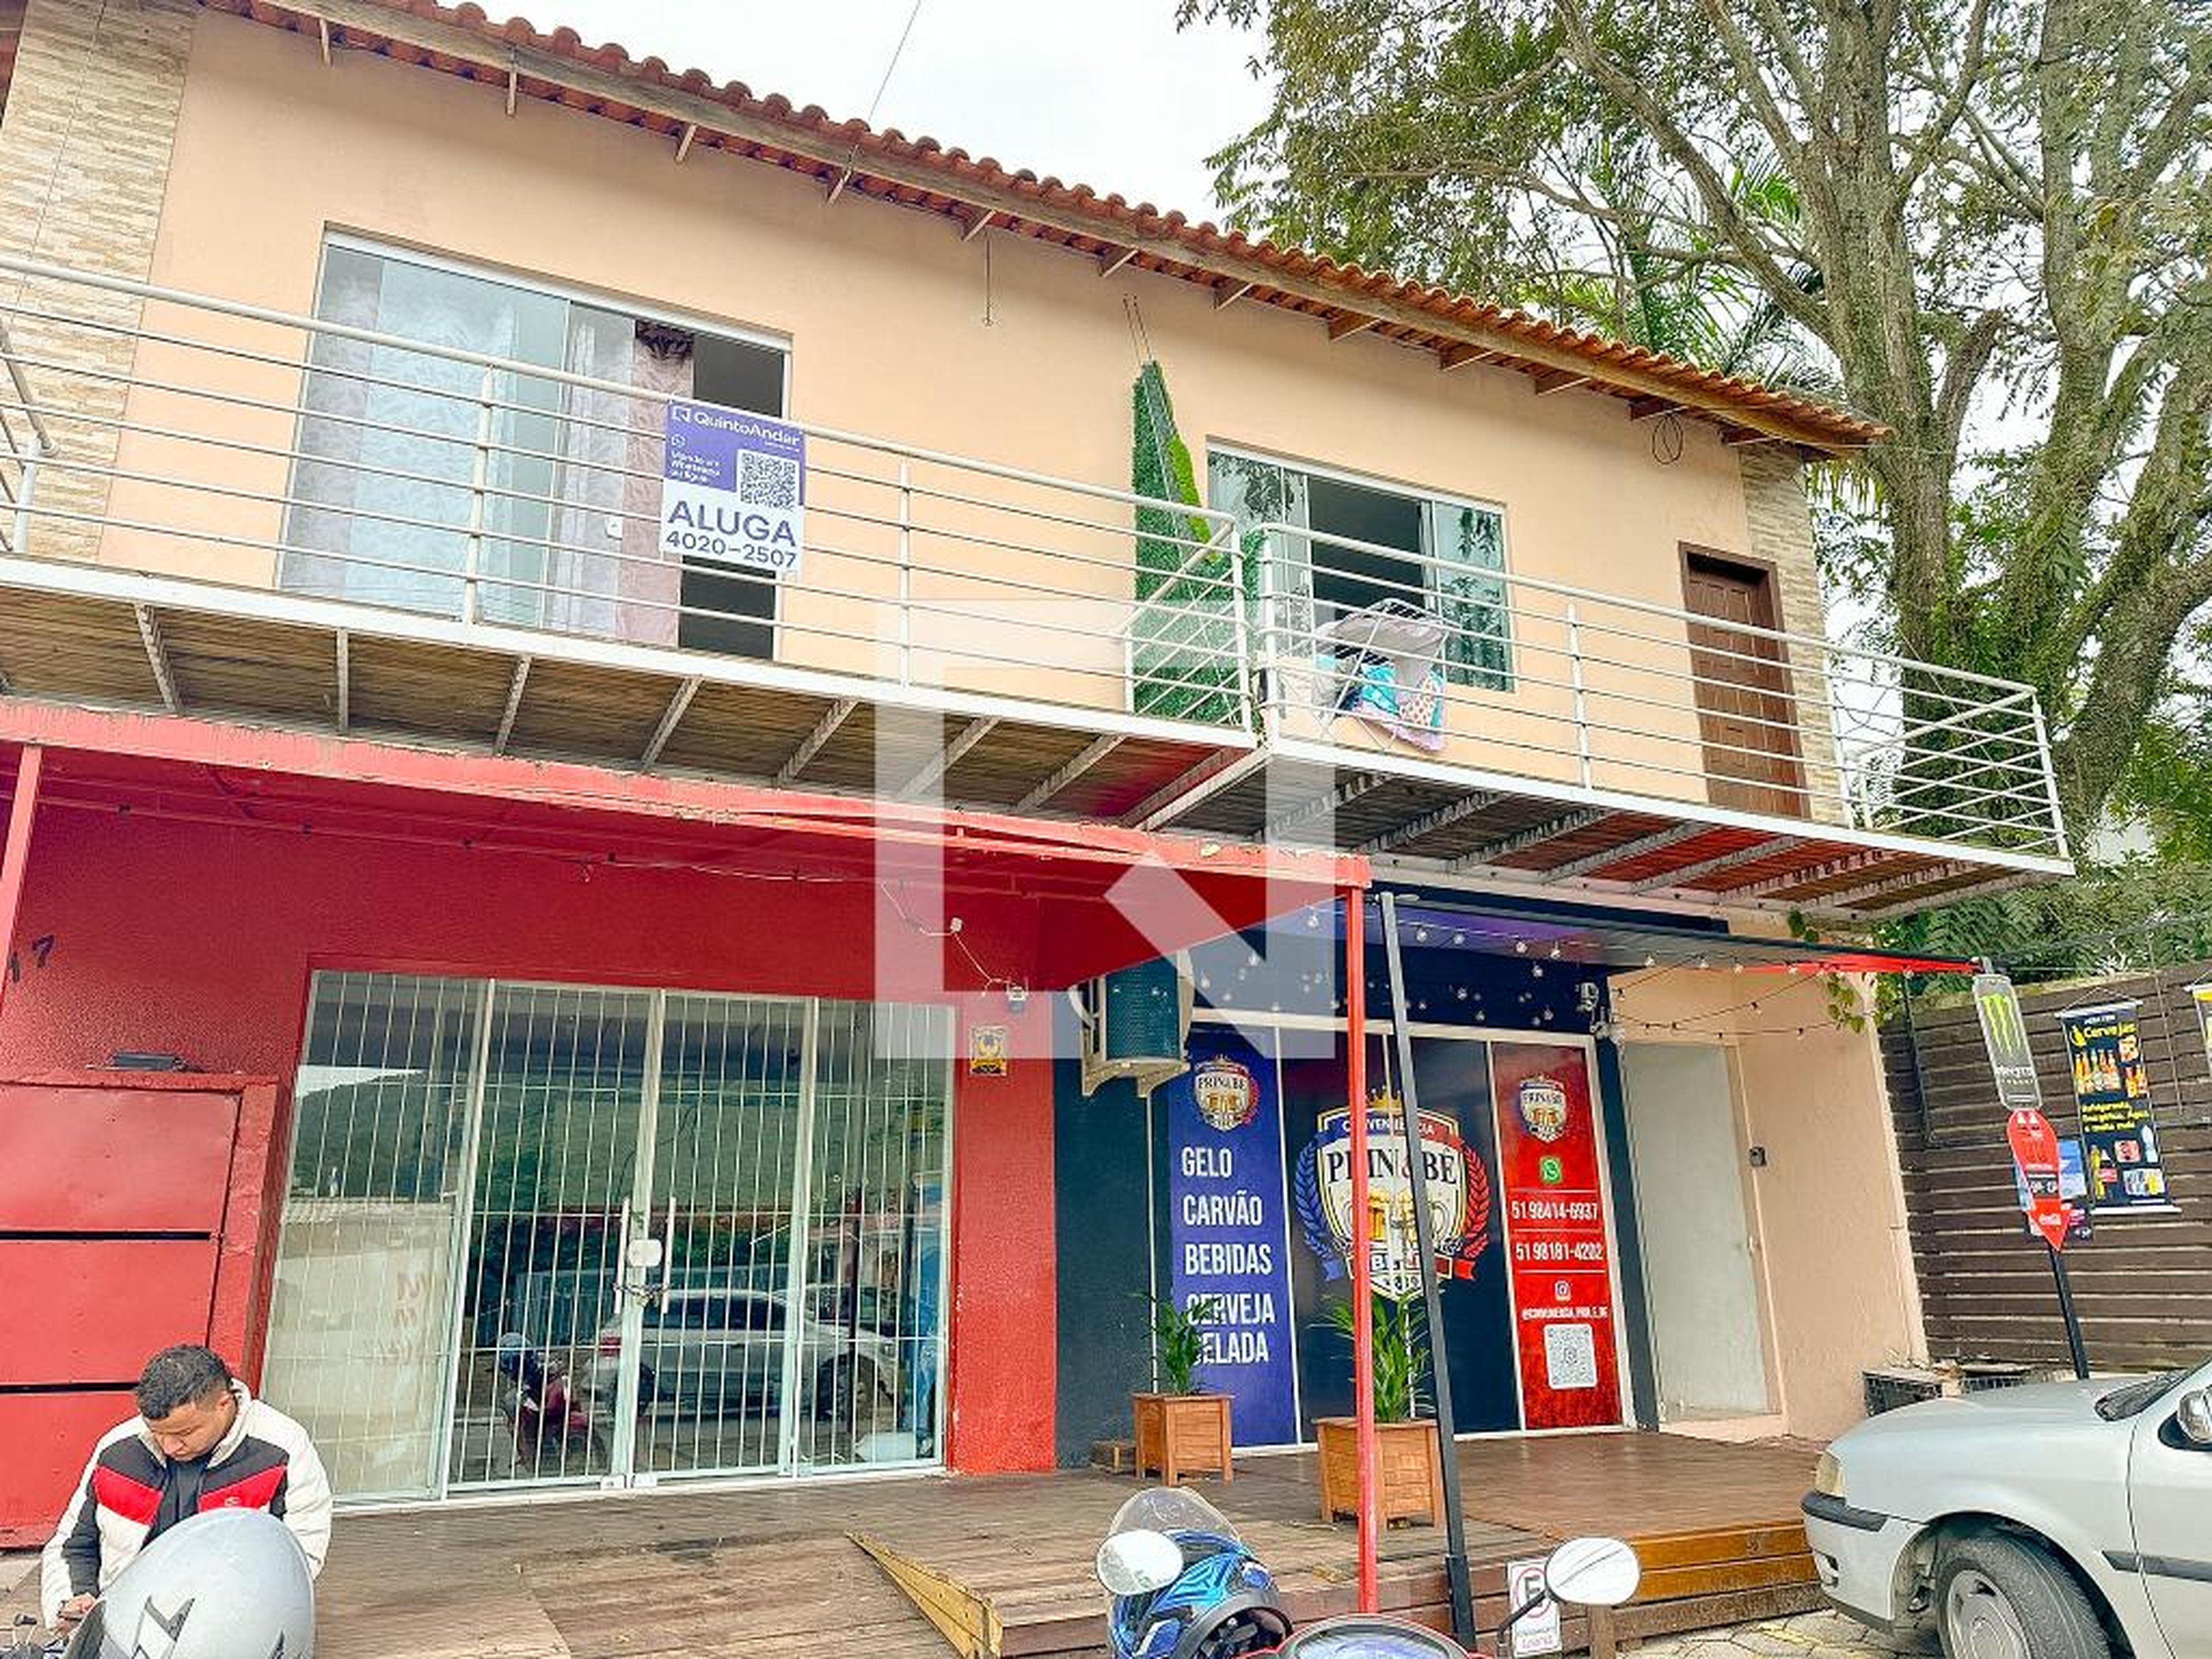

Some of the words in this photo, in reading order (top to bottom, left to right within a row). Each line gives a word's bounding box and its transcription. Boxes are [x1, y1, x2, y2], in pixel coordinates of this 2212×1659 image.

[694, 411, 800, 446] QuintoAndar
[666, 500, 797, 547] ALUGA
[666, 530, 797, 569] 4020-2507
[1181, 1146, 1232, 1177] GELO
[1183, 1190, 1263, 1226] CARVÃO
[1512, 1200, 1526, 1219] 51
[1185, 1243, 1272, 1275] BEBIDAS
[1516, 1242, 1530, 1260] 51
